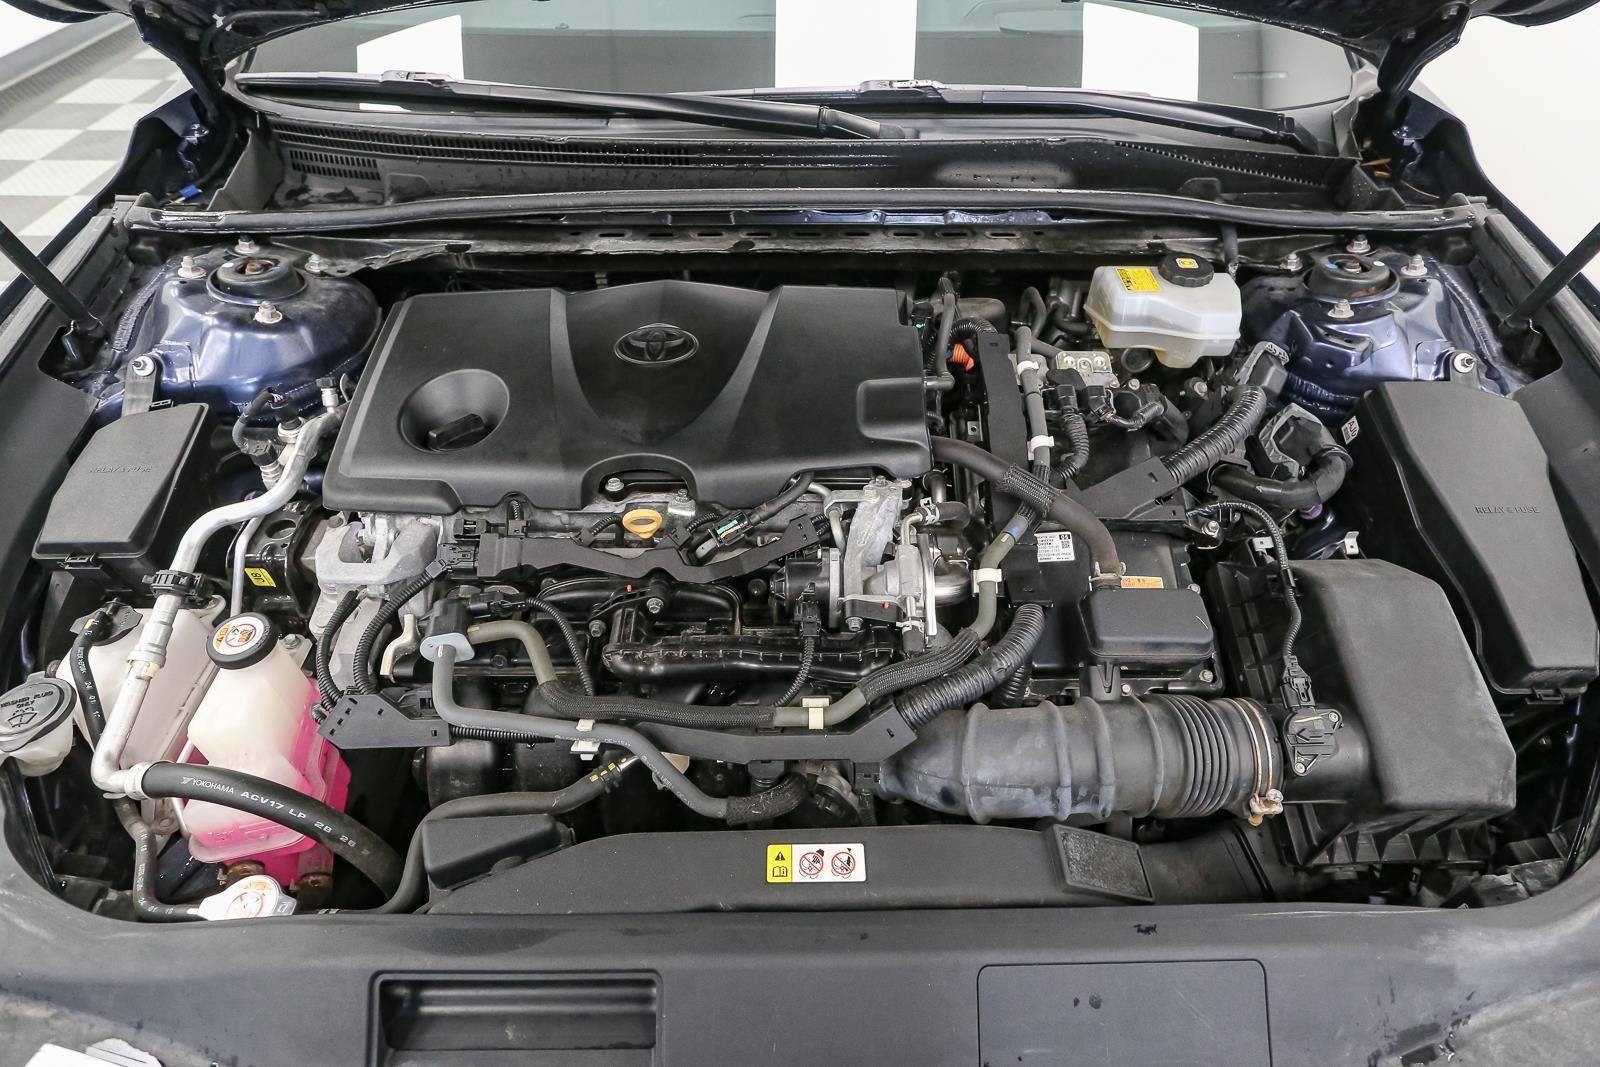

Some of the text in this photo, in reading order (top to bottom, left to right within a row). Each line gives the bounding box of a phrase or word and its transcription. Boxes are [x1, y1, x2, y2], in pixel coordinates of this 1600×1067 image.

[1473, 504, 1504, 514] RELAY
[1514, 504, 1540, 514] FUSE
[192, 778, 235, 795] YOKOHAMA
[240, 791, 285, 810] ACV17
[288, 808, 307, 820] LP
